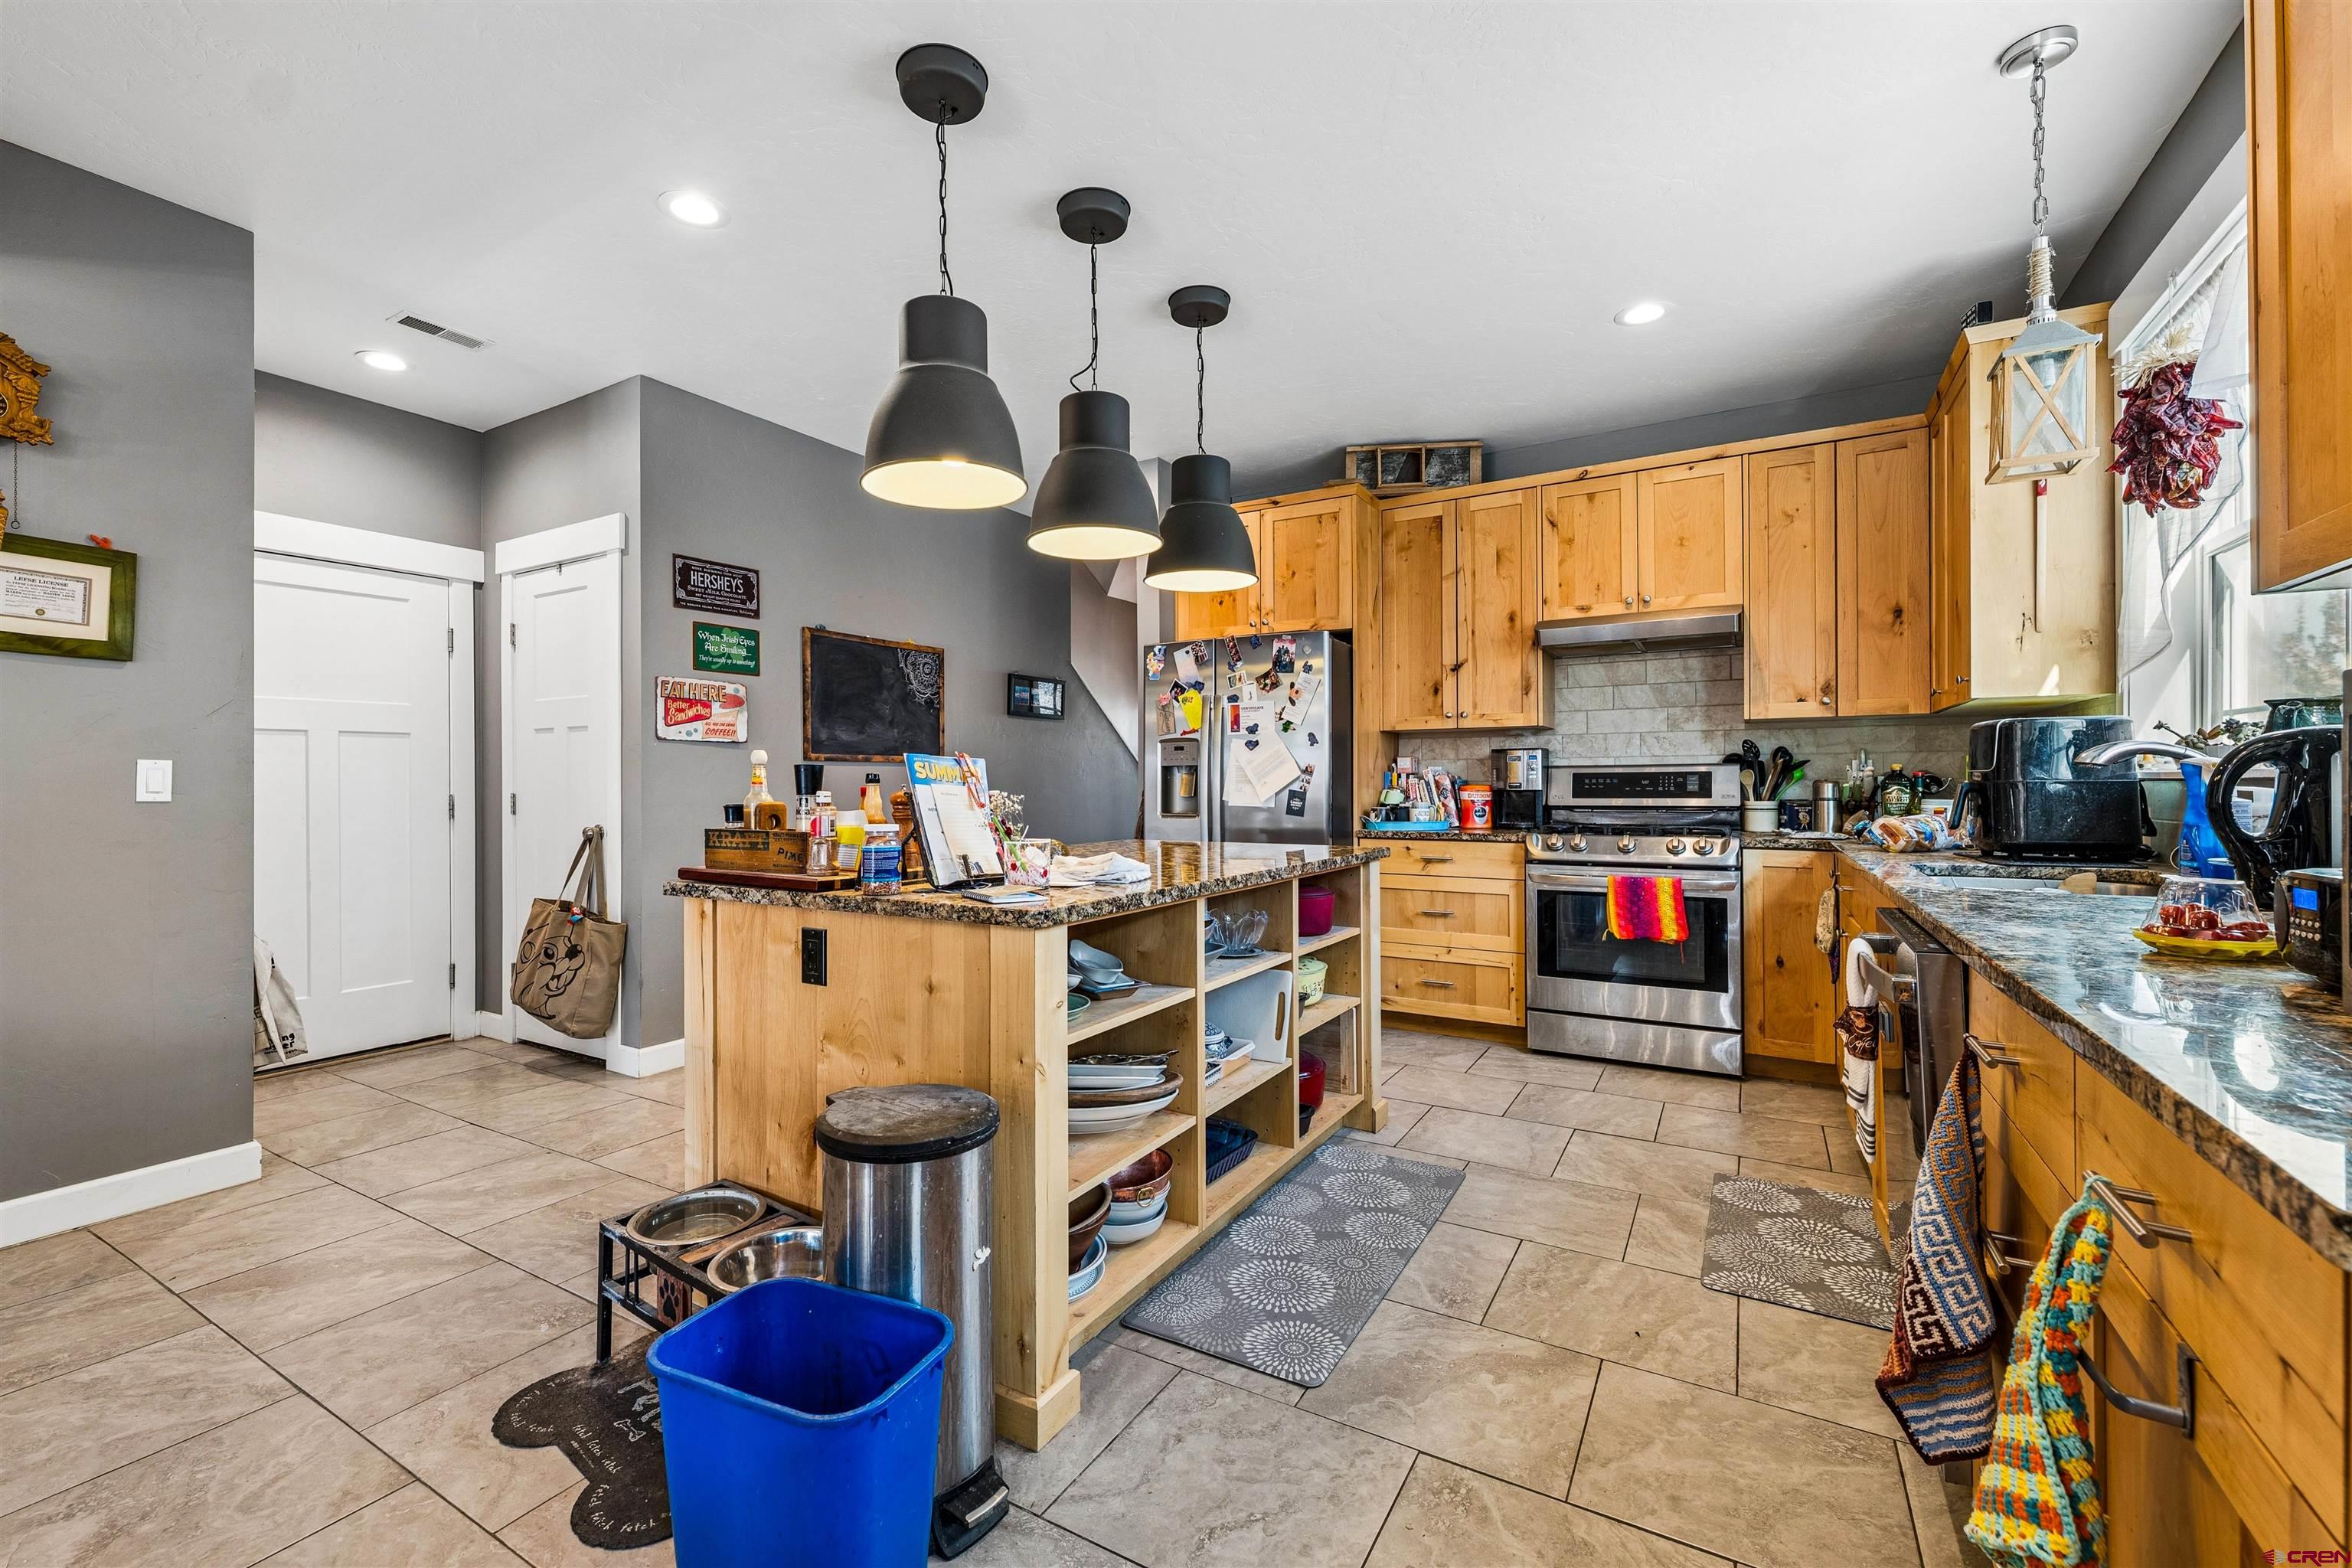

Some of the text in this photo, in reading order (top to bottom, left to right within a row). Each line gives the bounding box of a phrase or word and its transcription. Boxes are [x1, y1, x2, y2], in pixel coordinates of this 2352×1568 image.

[691, 570, 743, 593] HERSHEY'S
[688, 585, 704, 593] SWEET
[721, 591, 746, 599] CHOCOLATE
[698, 631, 755, 647] When Irish Eyes
[705, 642, 718, 652] Are
[661, 680, 727, 703] EAT HERE
[668, 700, 690, 708] Better
[668, 704, 710, 724] Sandwiches
[914, 761, 982, 784] SUMM
[620, 1519, 655, 1532] fetch
